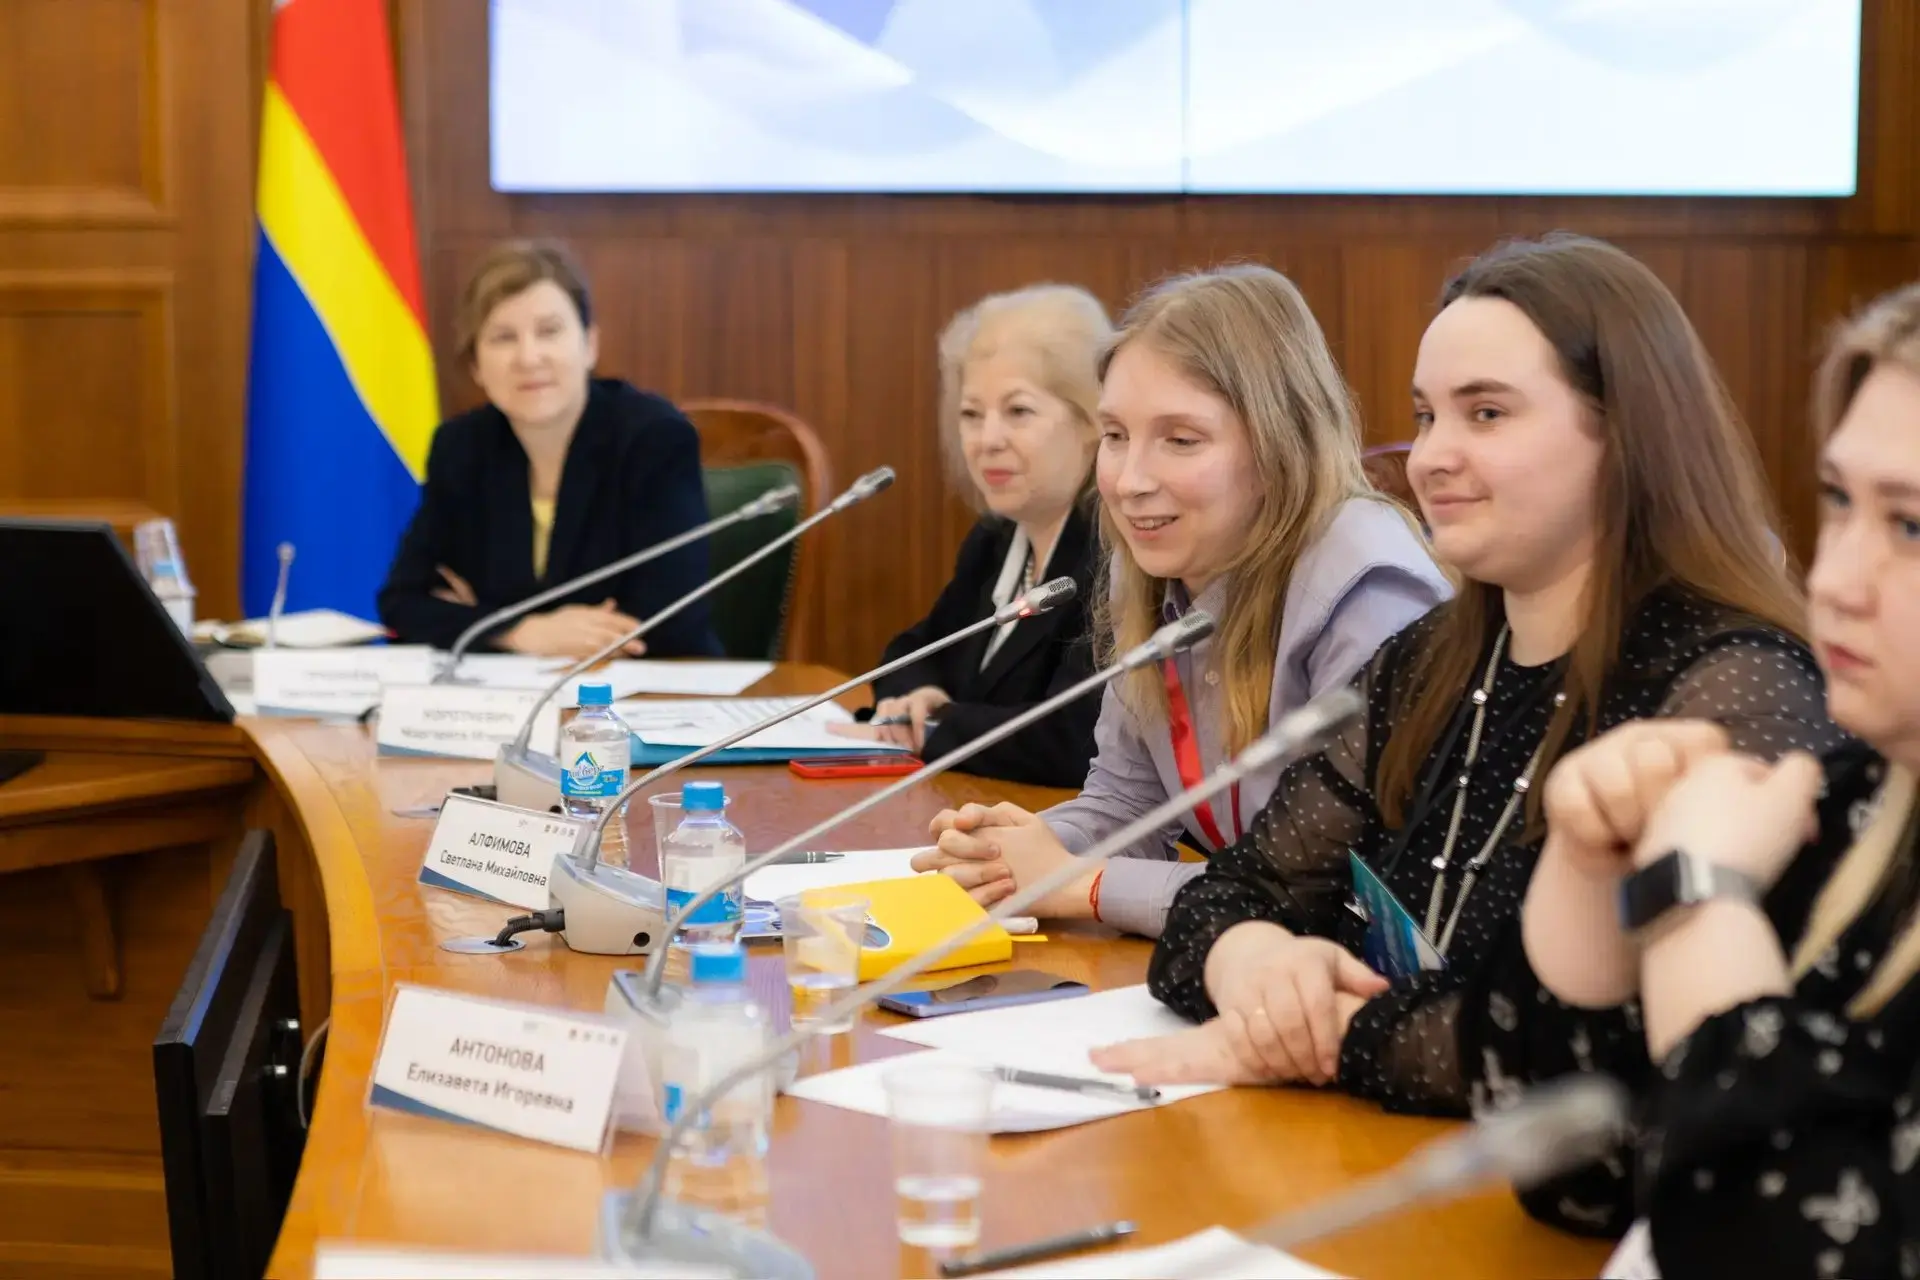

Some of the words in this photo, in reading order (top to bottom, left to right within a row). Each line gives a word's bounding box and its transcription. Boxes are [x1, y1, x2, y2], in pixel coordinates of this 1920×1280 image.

[468, 832, 532, 858] АЛФИМОВА
[440, 849, 483, 872] Светлана
[485, 861, 547, 886] Михайловна
[449, 1037, 545, 1074] АНТОНОВА
[406, 1062, 489, 1096] Елизавета
[493, 1081, 575, 1115] Игоревна
